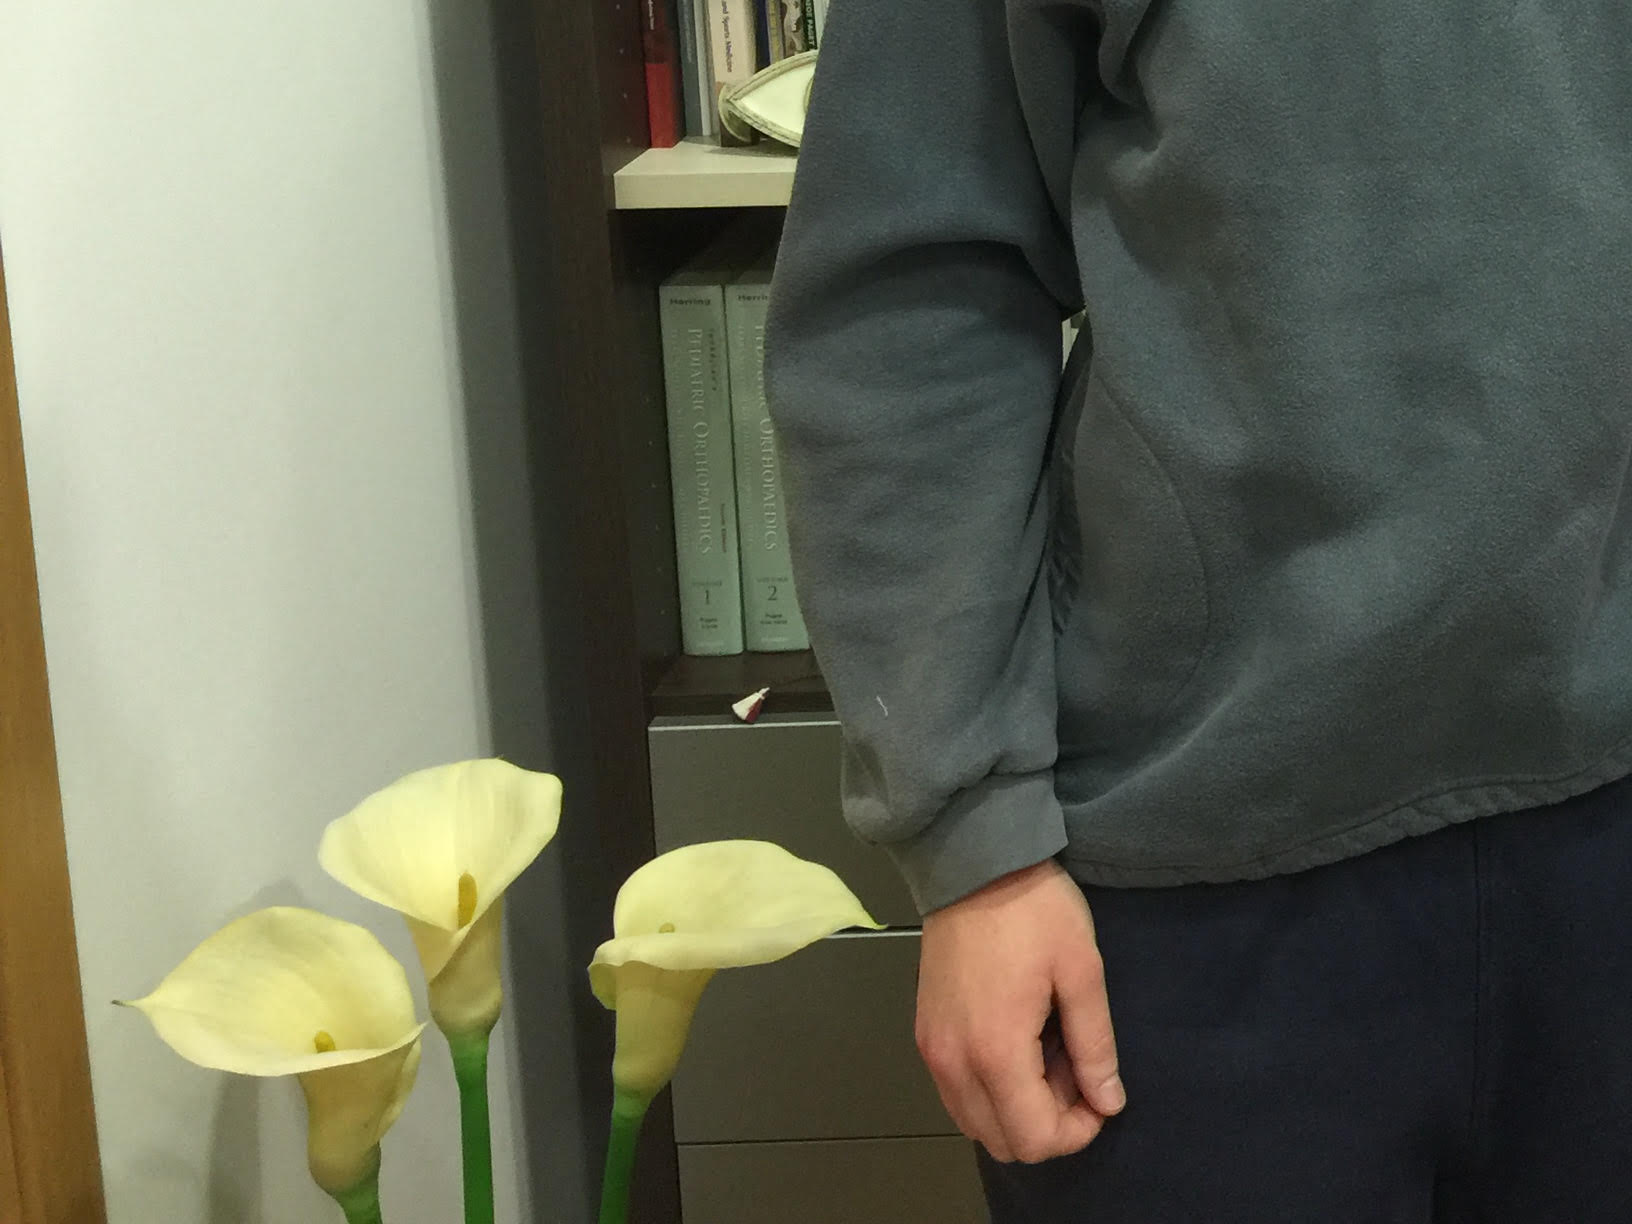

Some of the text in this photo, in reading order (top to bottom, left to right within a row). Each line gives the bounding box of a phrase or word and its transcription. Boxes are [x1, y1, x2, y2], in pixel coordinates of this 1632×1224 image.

[721, 1, 729, 16] and
[722, 16, 731, 39] Sports
[807, 19, 815, 46] PAGET
[670, 297, 711, 306] Herring
[688, 328, 713, 555] PEDIATRIC ORTHOPAEDICS
[704, 589, 711, 605] 1
[767, 585, 778, 602] 2
